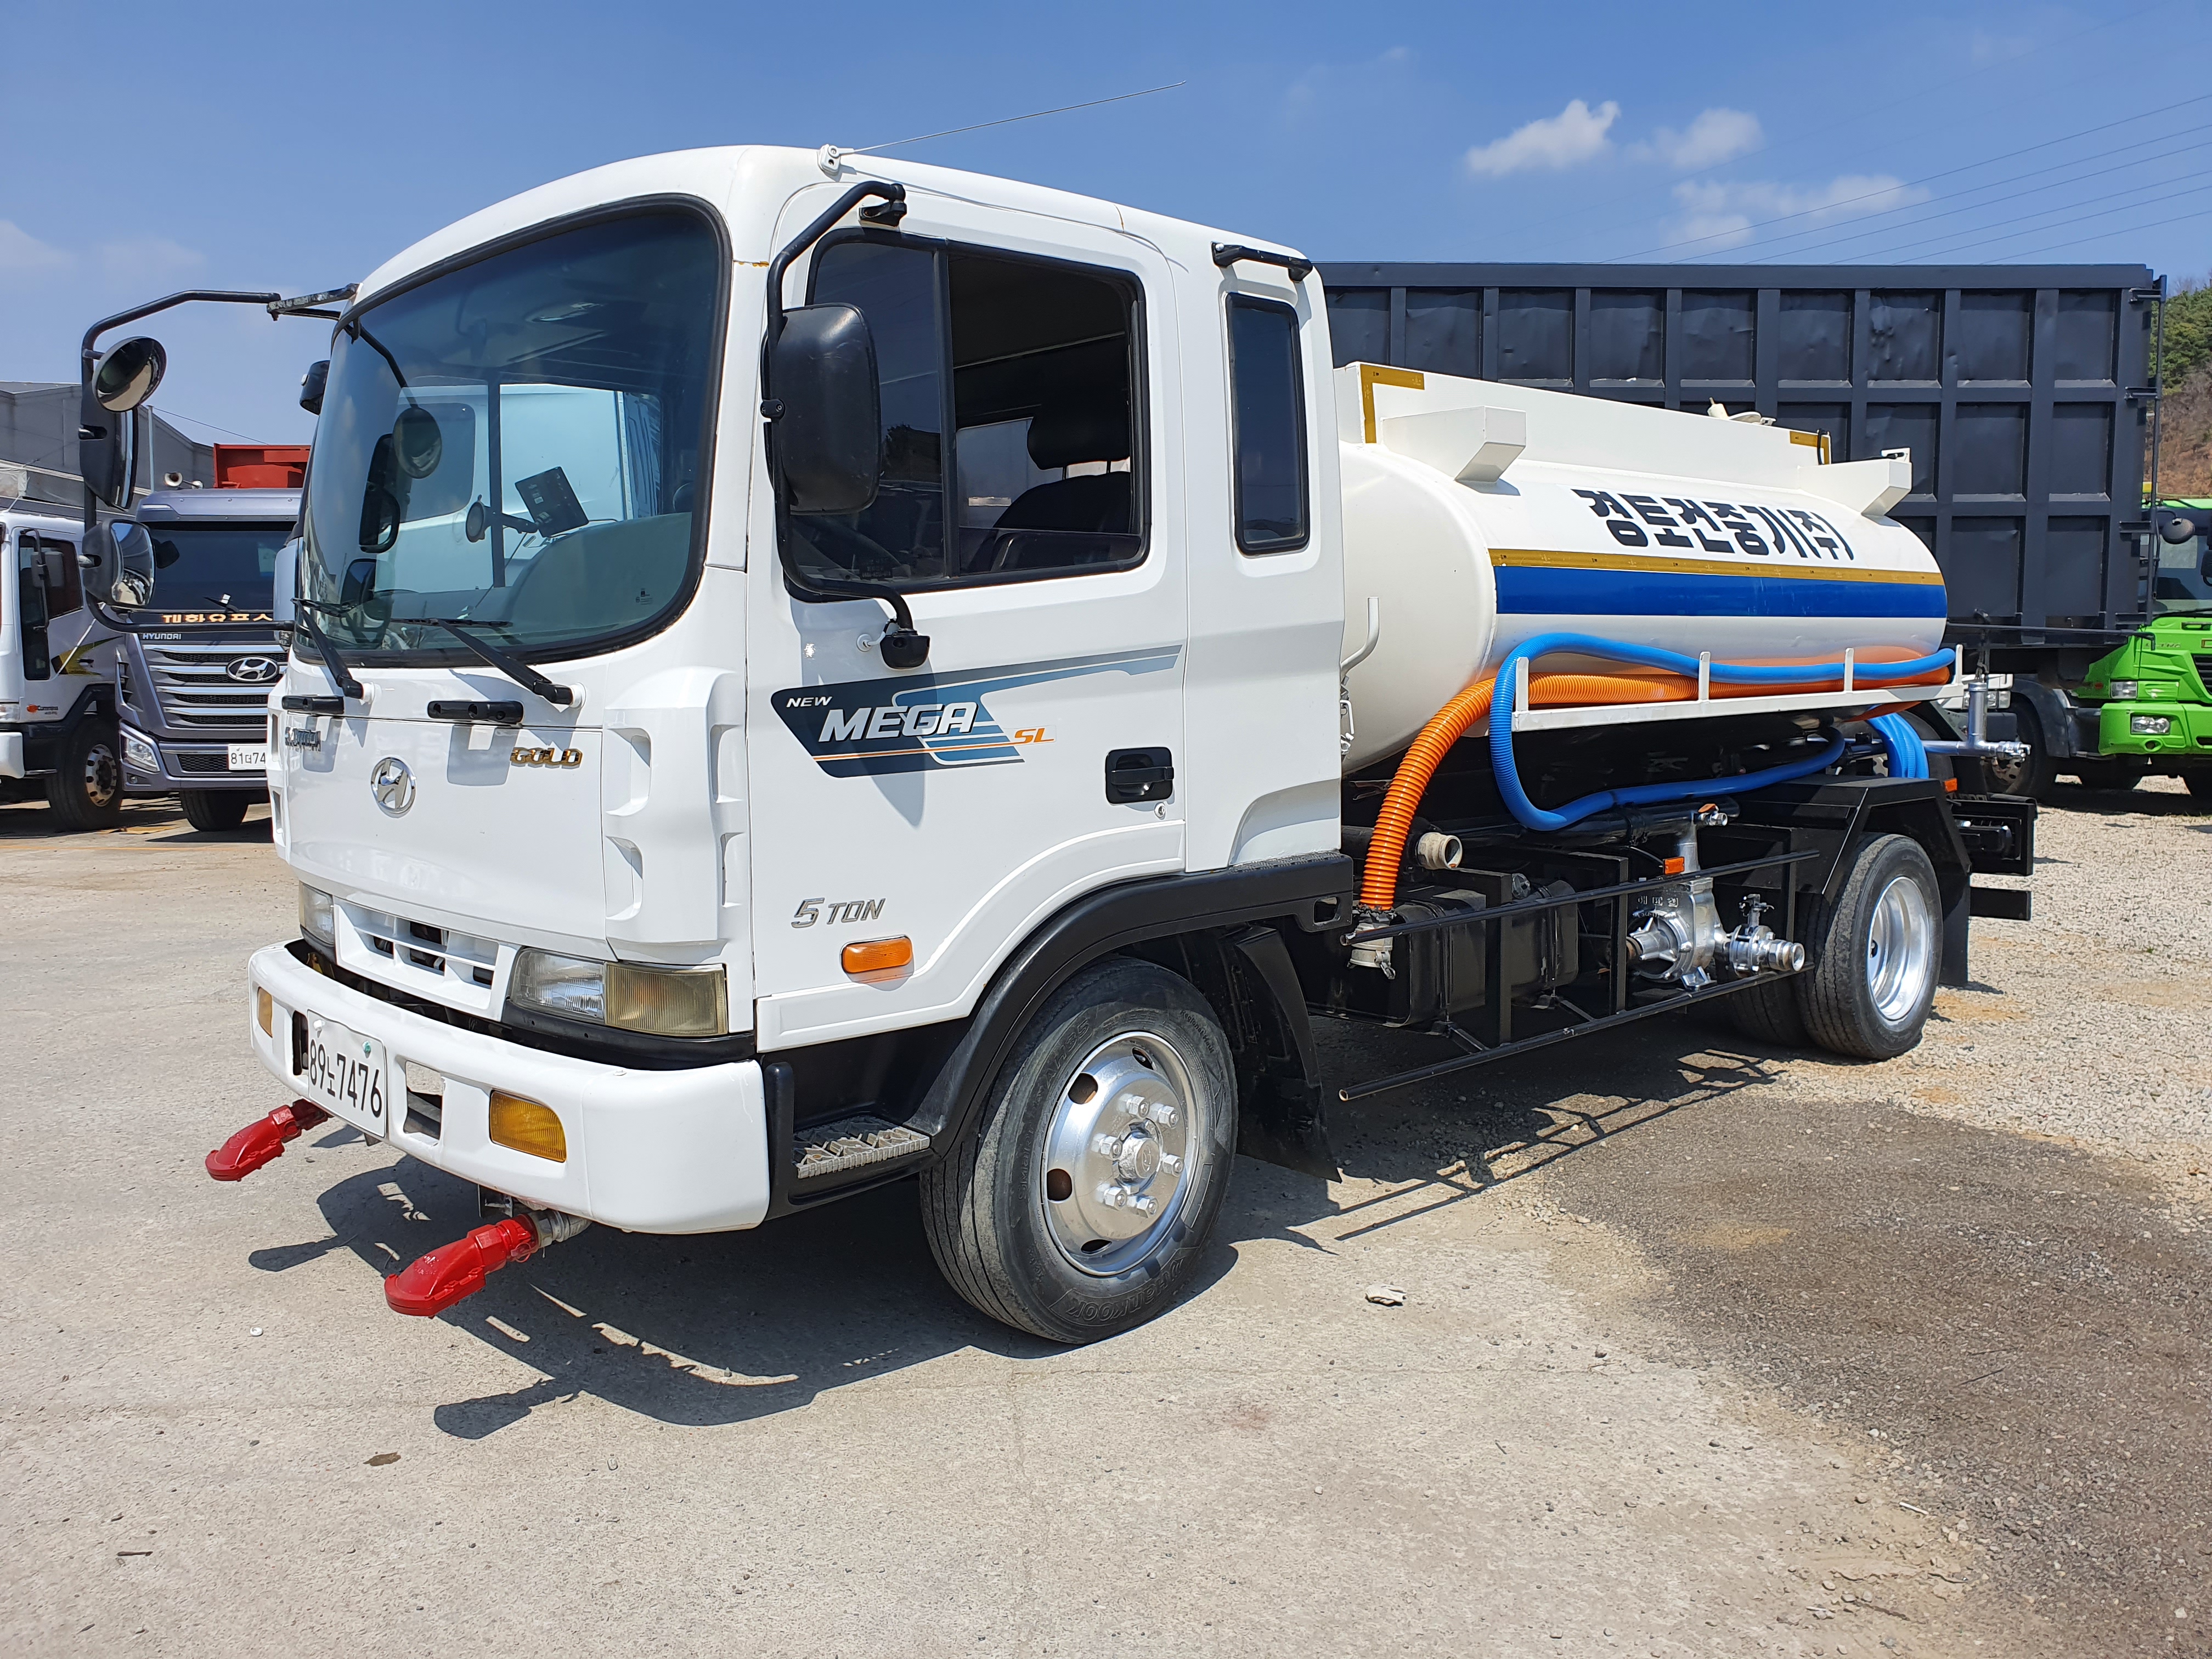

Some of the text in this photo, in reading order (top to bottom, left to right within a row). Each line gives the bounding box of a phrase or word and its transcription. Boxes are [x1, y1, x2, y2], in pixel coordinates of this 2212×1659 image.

[786, 696, 833, 708] NEW
[818, 701, 1055, 743] MEGA SL
[510, 747, 583, 767] GOLD
[791, 897, 887, 929] 5 TON
[310, 1039, 382, 1118] 89노7476
